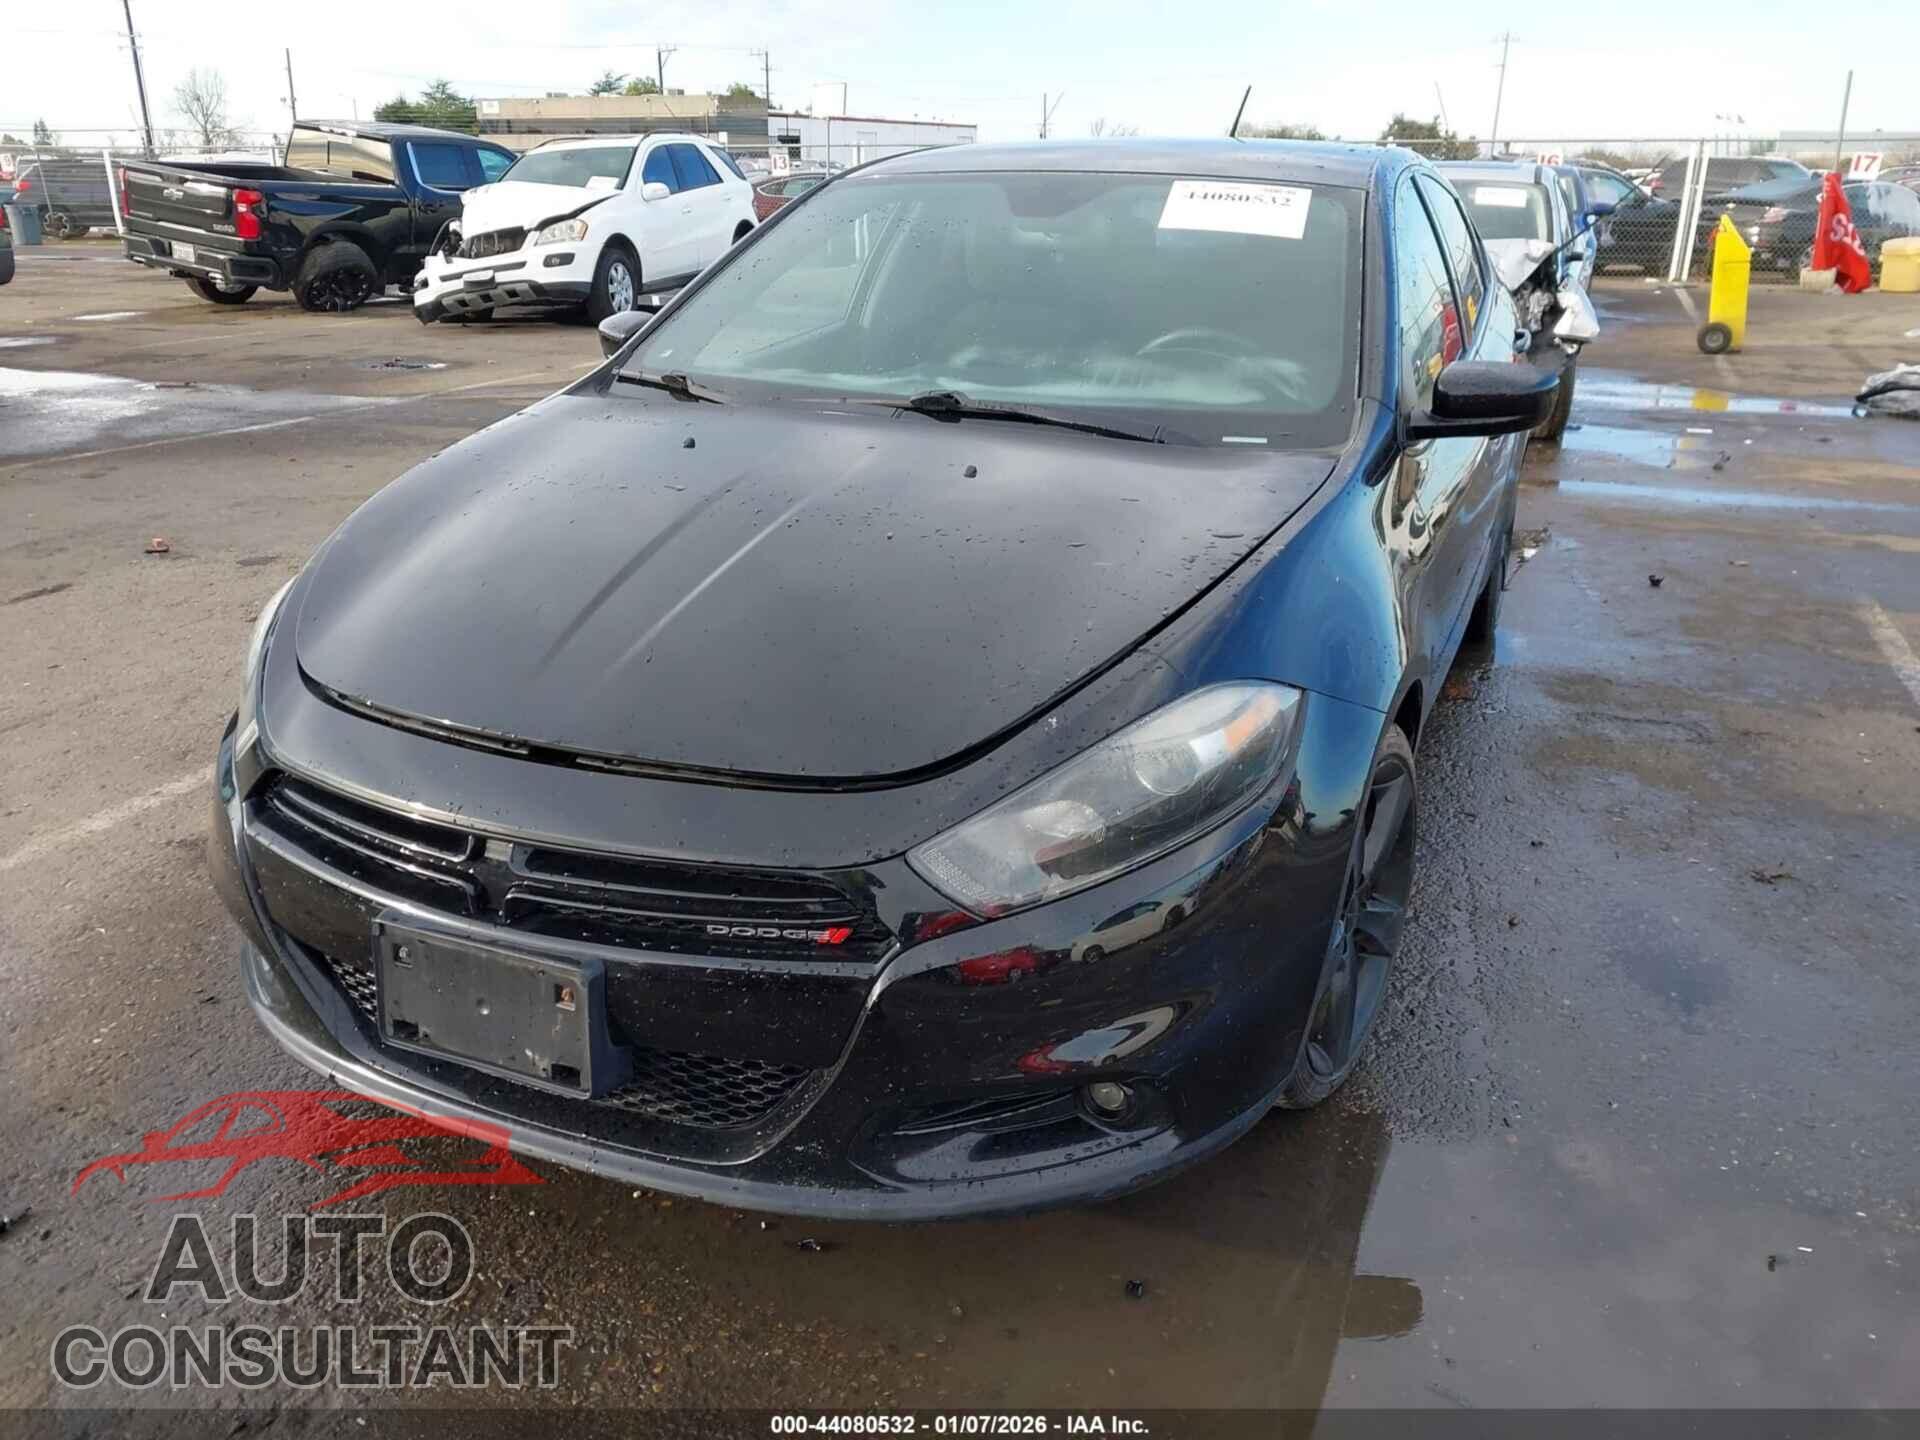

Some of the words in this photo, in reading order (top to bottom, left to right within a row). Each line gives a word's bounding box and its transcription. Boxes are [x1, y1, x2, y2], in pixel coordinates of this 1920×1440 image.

[773, 156, 788, 170] 13
[1853, 154, 1879, 172] 17
[706, 924, 832, 943] DODGE
